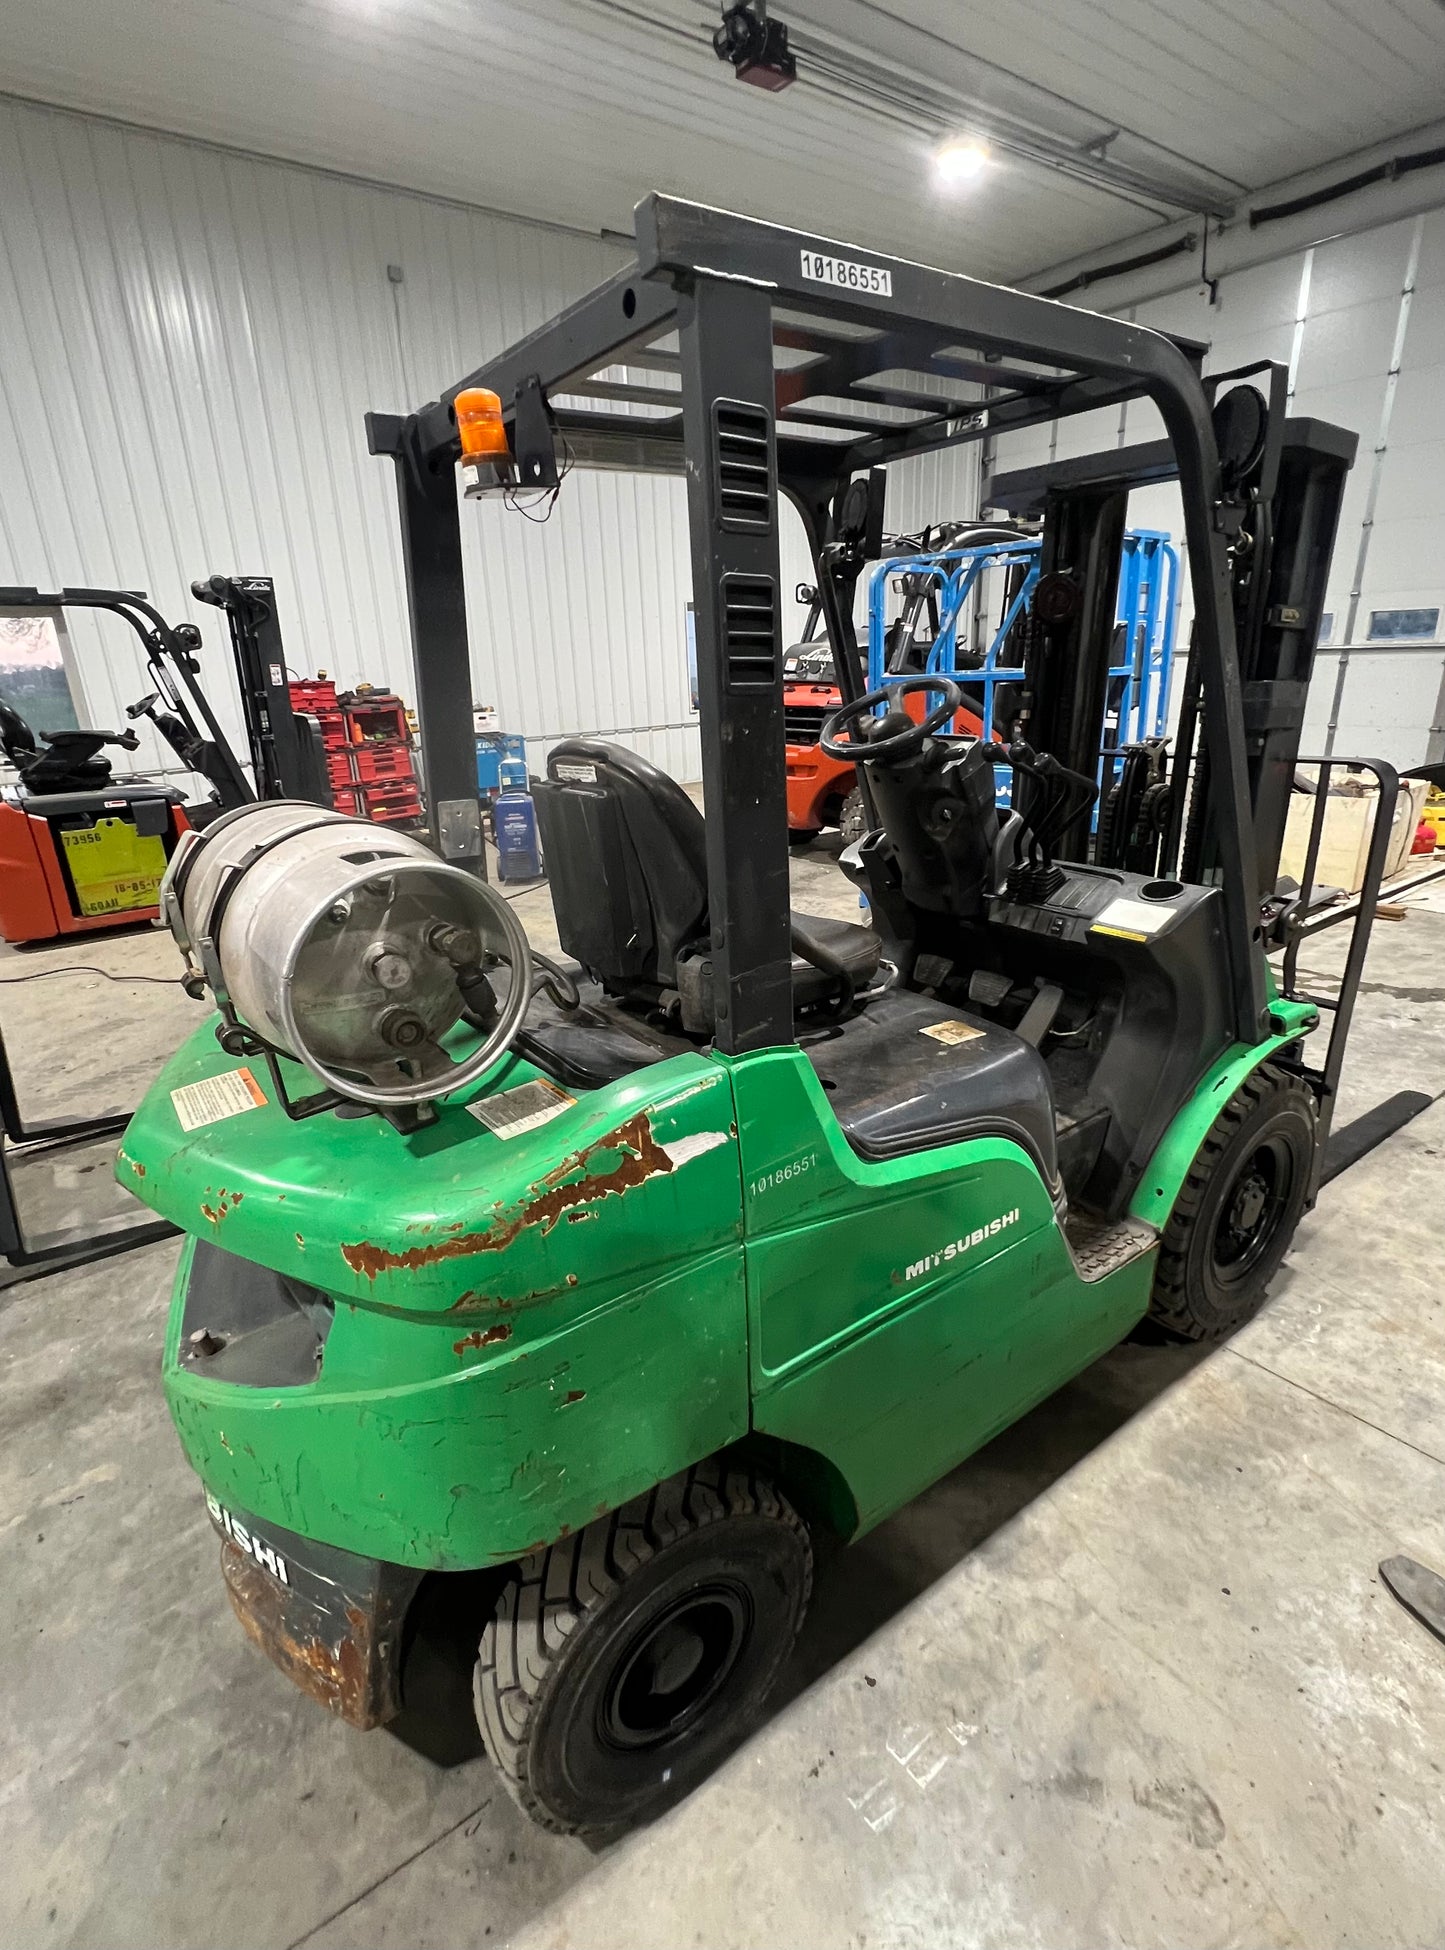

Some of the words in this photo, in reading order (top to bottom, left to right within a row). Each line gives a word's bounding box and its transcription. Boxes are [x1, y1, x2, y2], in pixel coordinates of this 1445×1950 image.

[803, 254, 889, 293] 10186551
[64, 832, 102, 847] 73956
[750, 1153, 816, 1196] 10186551
[905, 1208, 1019, 1280] MITSUBISHI
